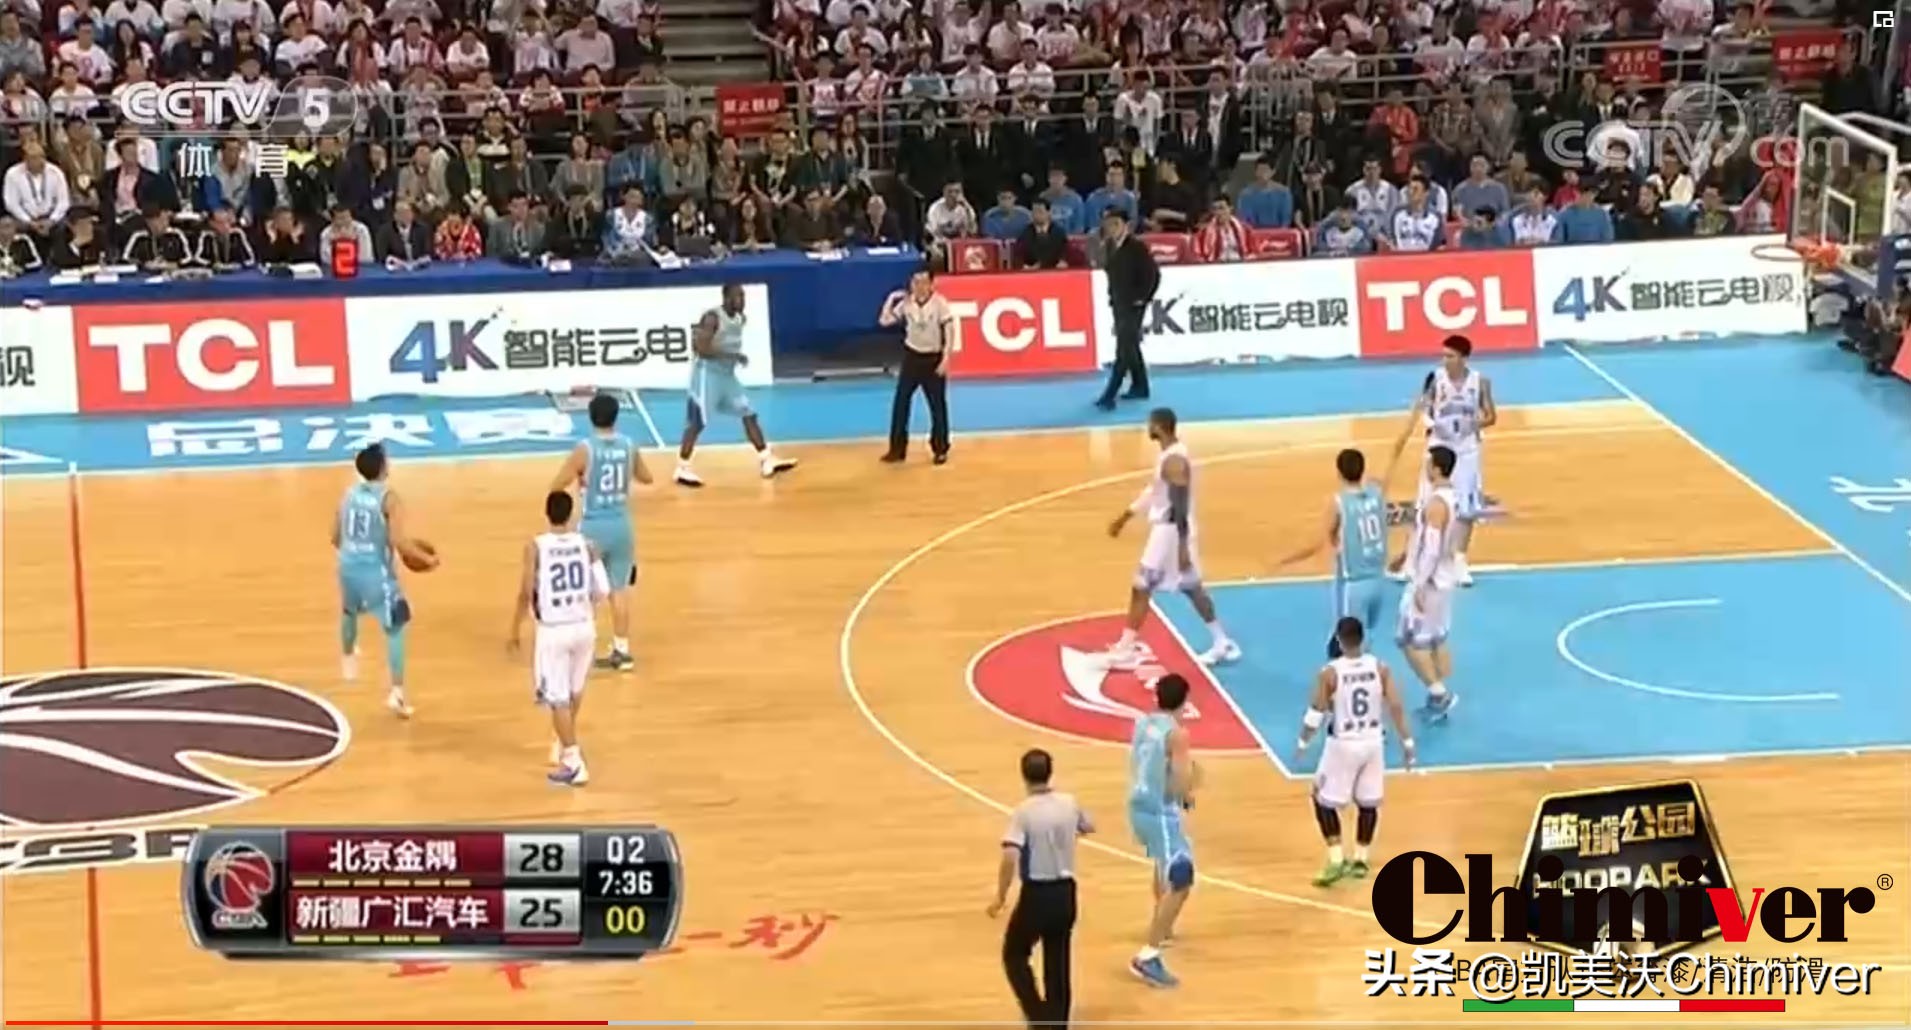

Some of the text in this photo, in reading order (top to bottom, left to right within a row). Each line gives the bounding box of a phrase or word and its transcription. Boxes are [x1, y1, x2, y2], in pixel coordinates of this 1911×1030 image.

[335, 241, 356, 275] 2
[1188, 297, 1349, 333] 智能云电视
[1367, 275, 1530, 332] TCL
[1553, 275, 1628, 322] 4K
[87, 317, 336, 393] TCL
[389, 318, 500, 384] 4K
[503, 324, 698, 371] 智能云电
[600, 463, 624, 491] 21
[1358, 514, 1382, 542] 10
[550, 560, 584, 593] 20
[1351, 687, 1369, 717] 6
